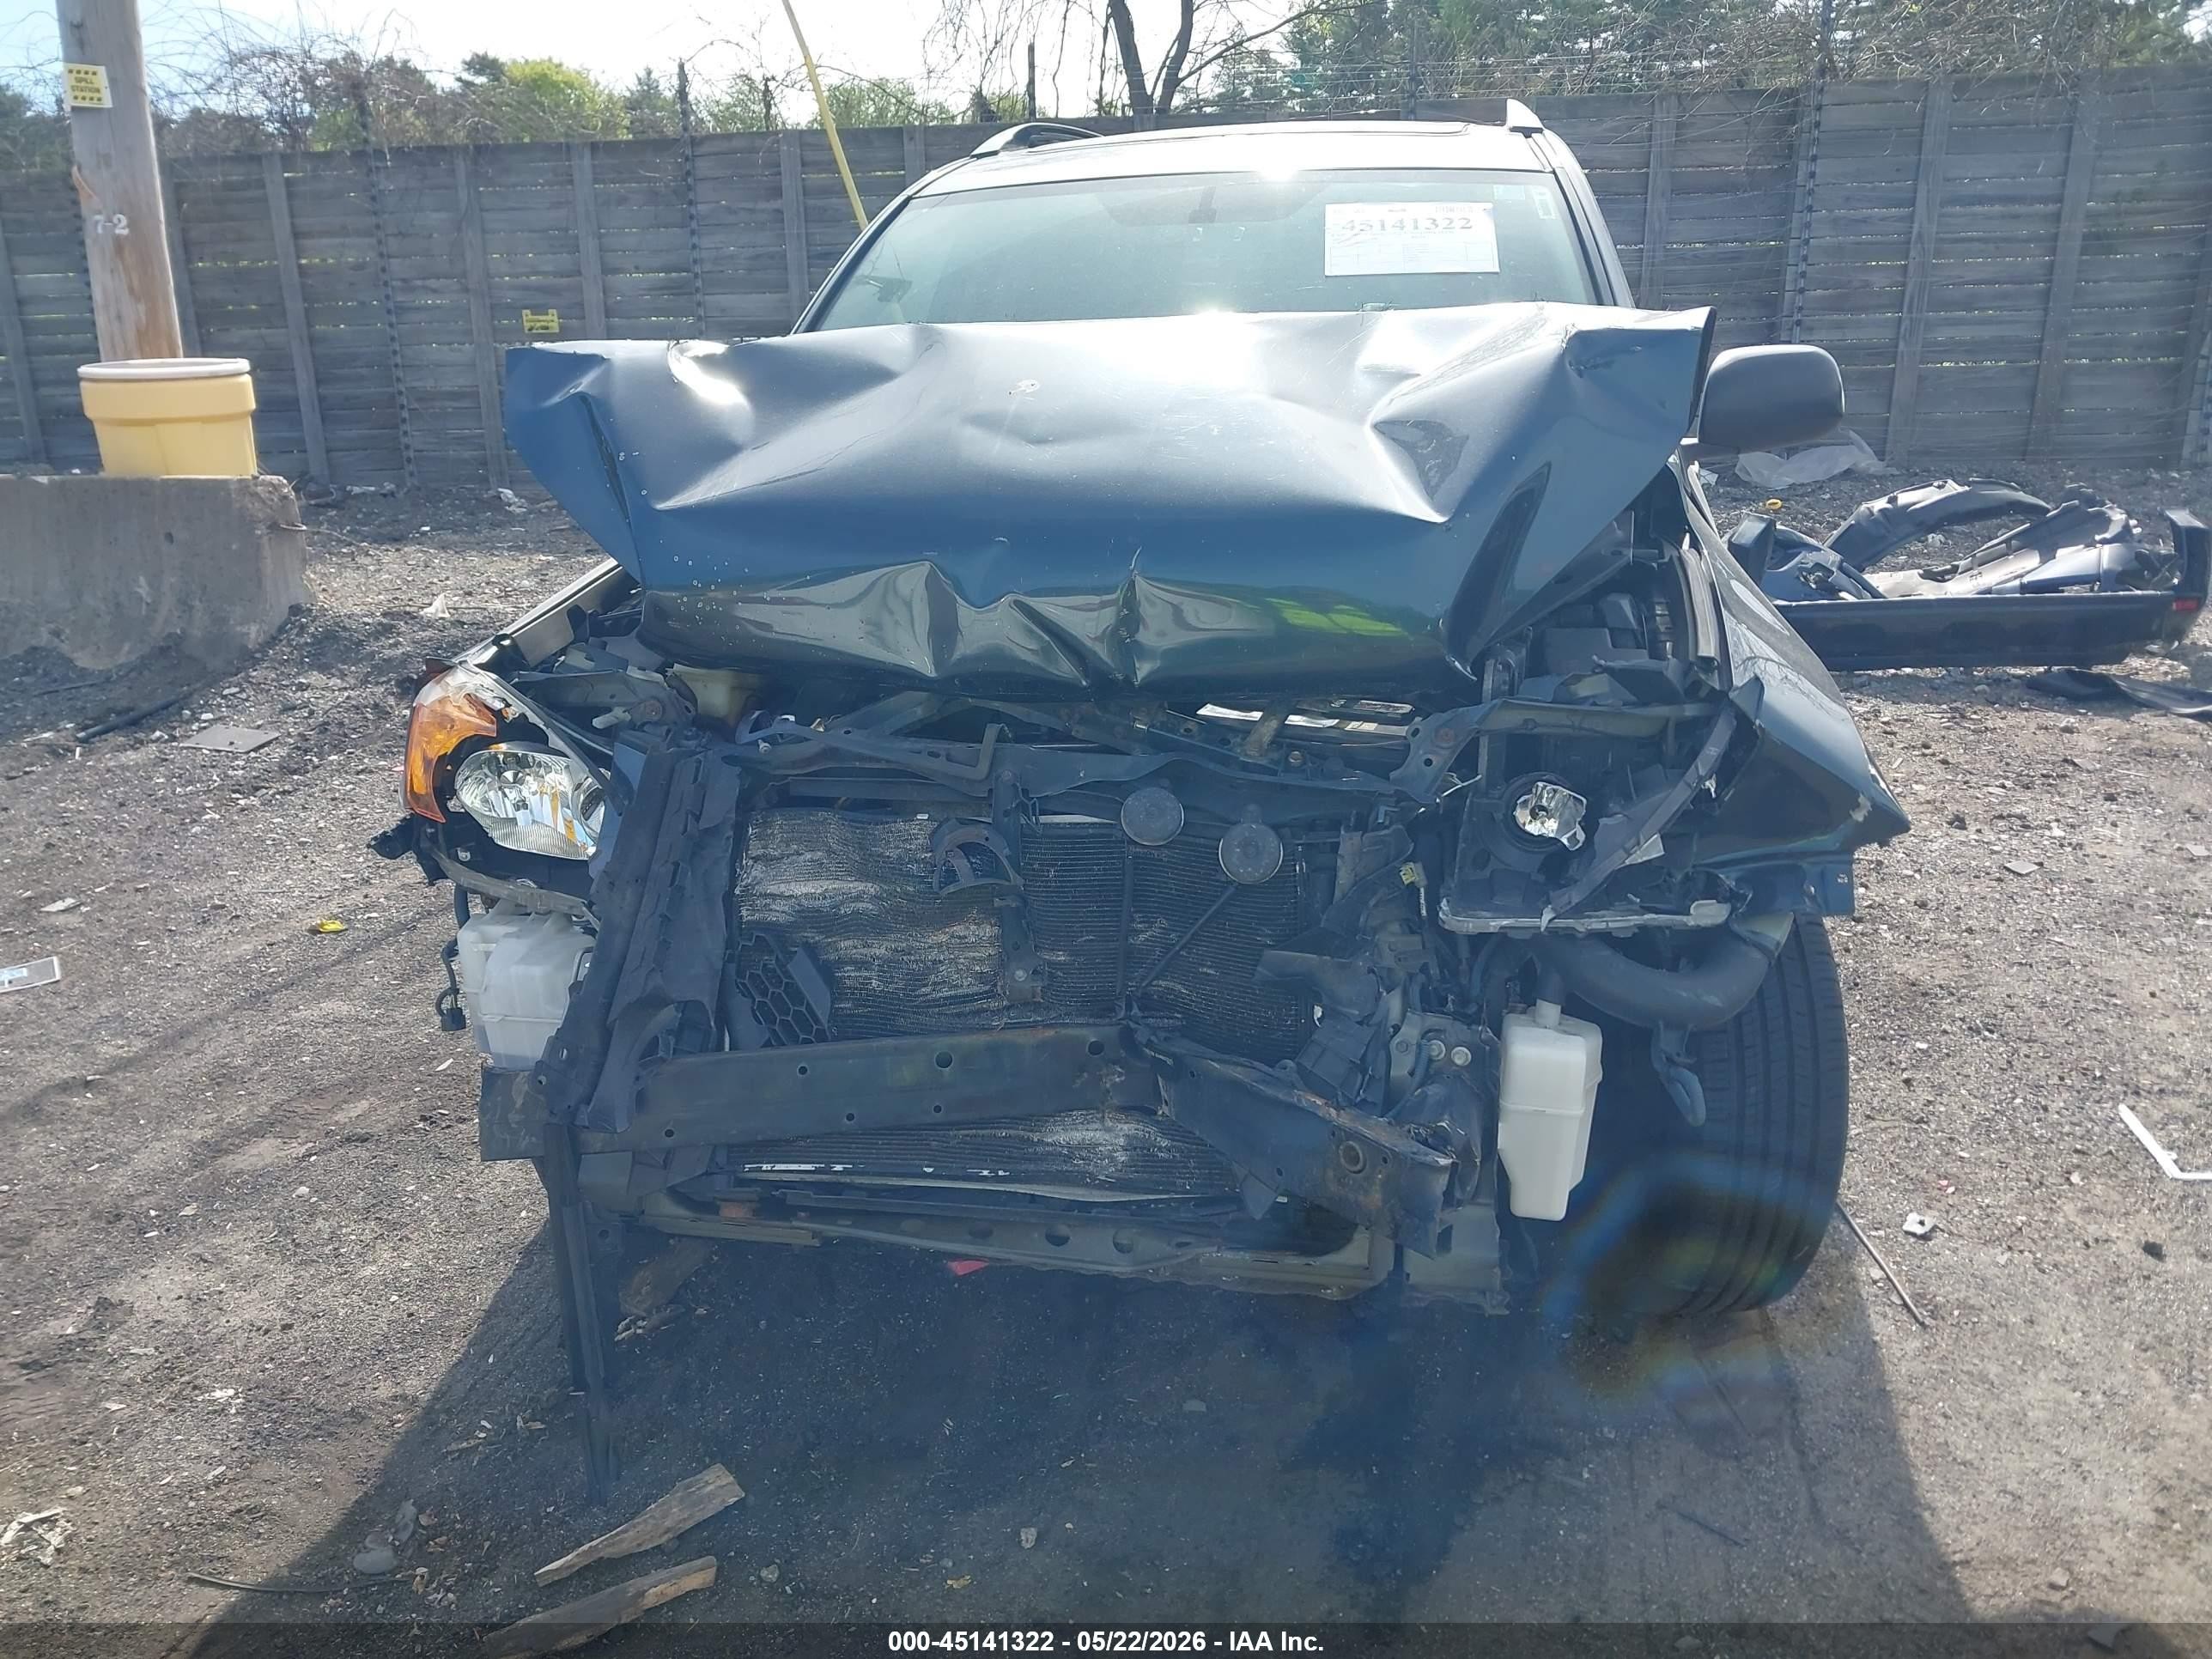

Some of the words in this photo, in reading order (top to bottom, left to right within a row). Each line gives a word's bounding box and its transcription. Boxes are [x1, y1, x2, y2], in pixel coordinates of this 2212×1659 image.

[70, 85, 100, 94] STATION
[94, 214, 129, 234] 7-2
[1341, 217, 1474, 232] 45141322
